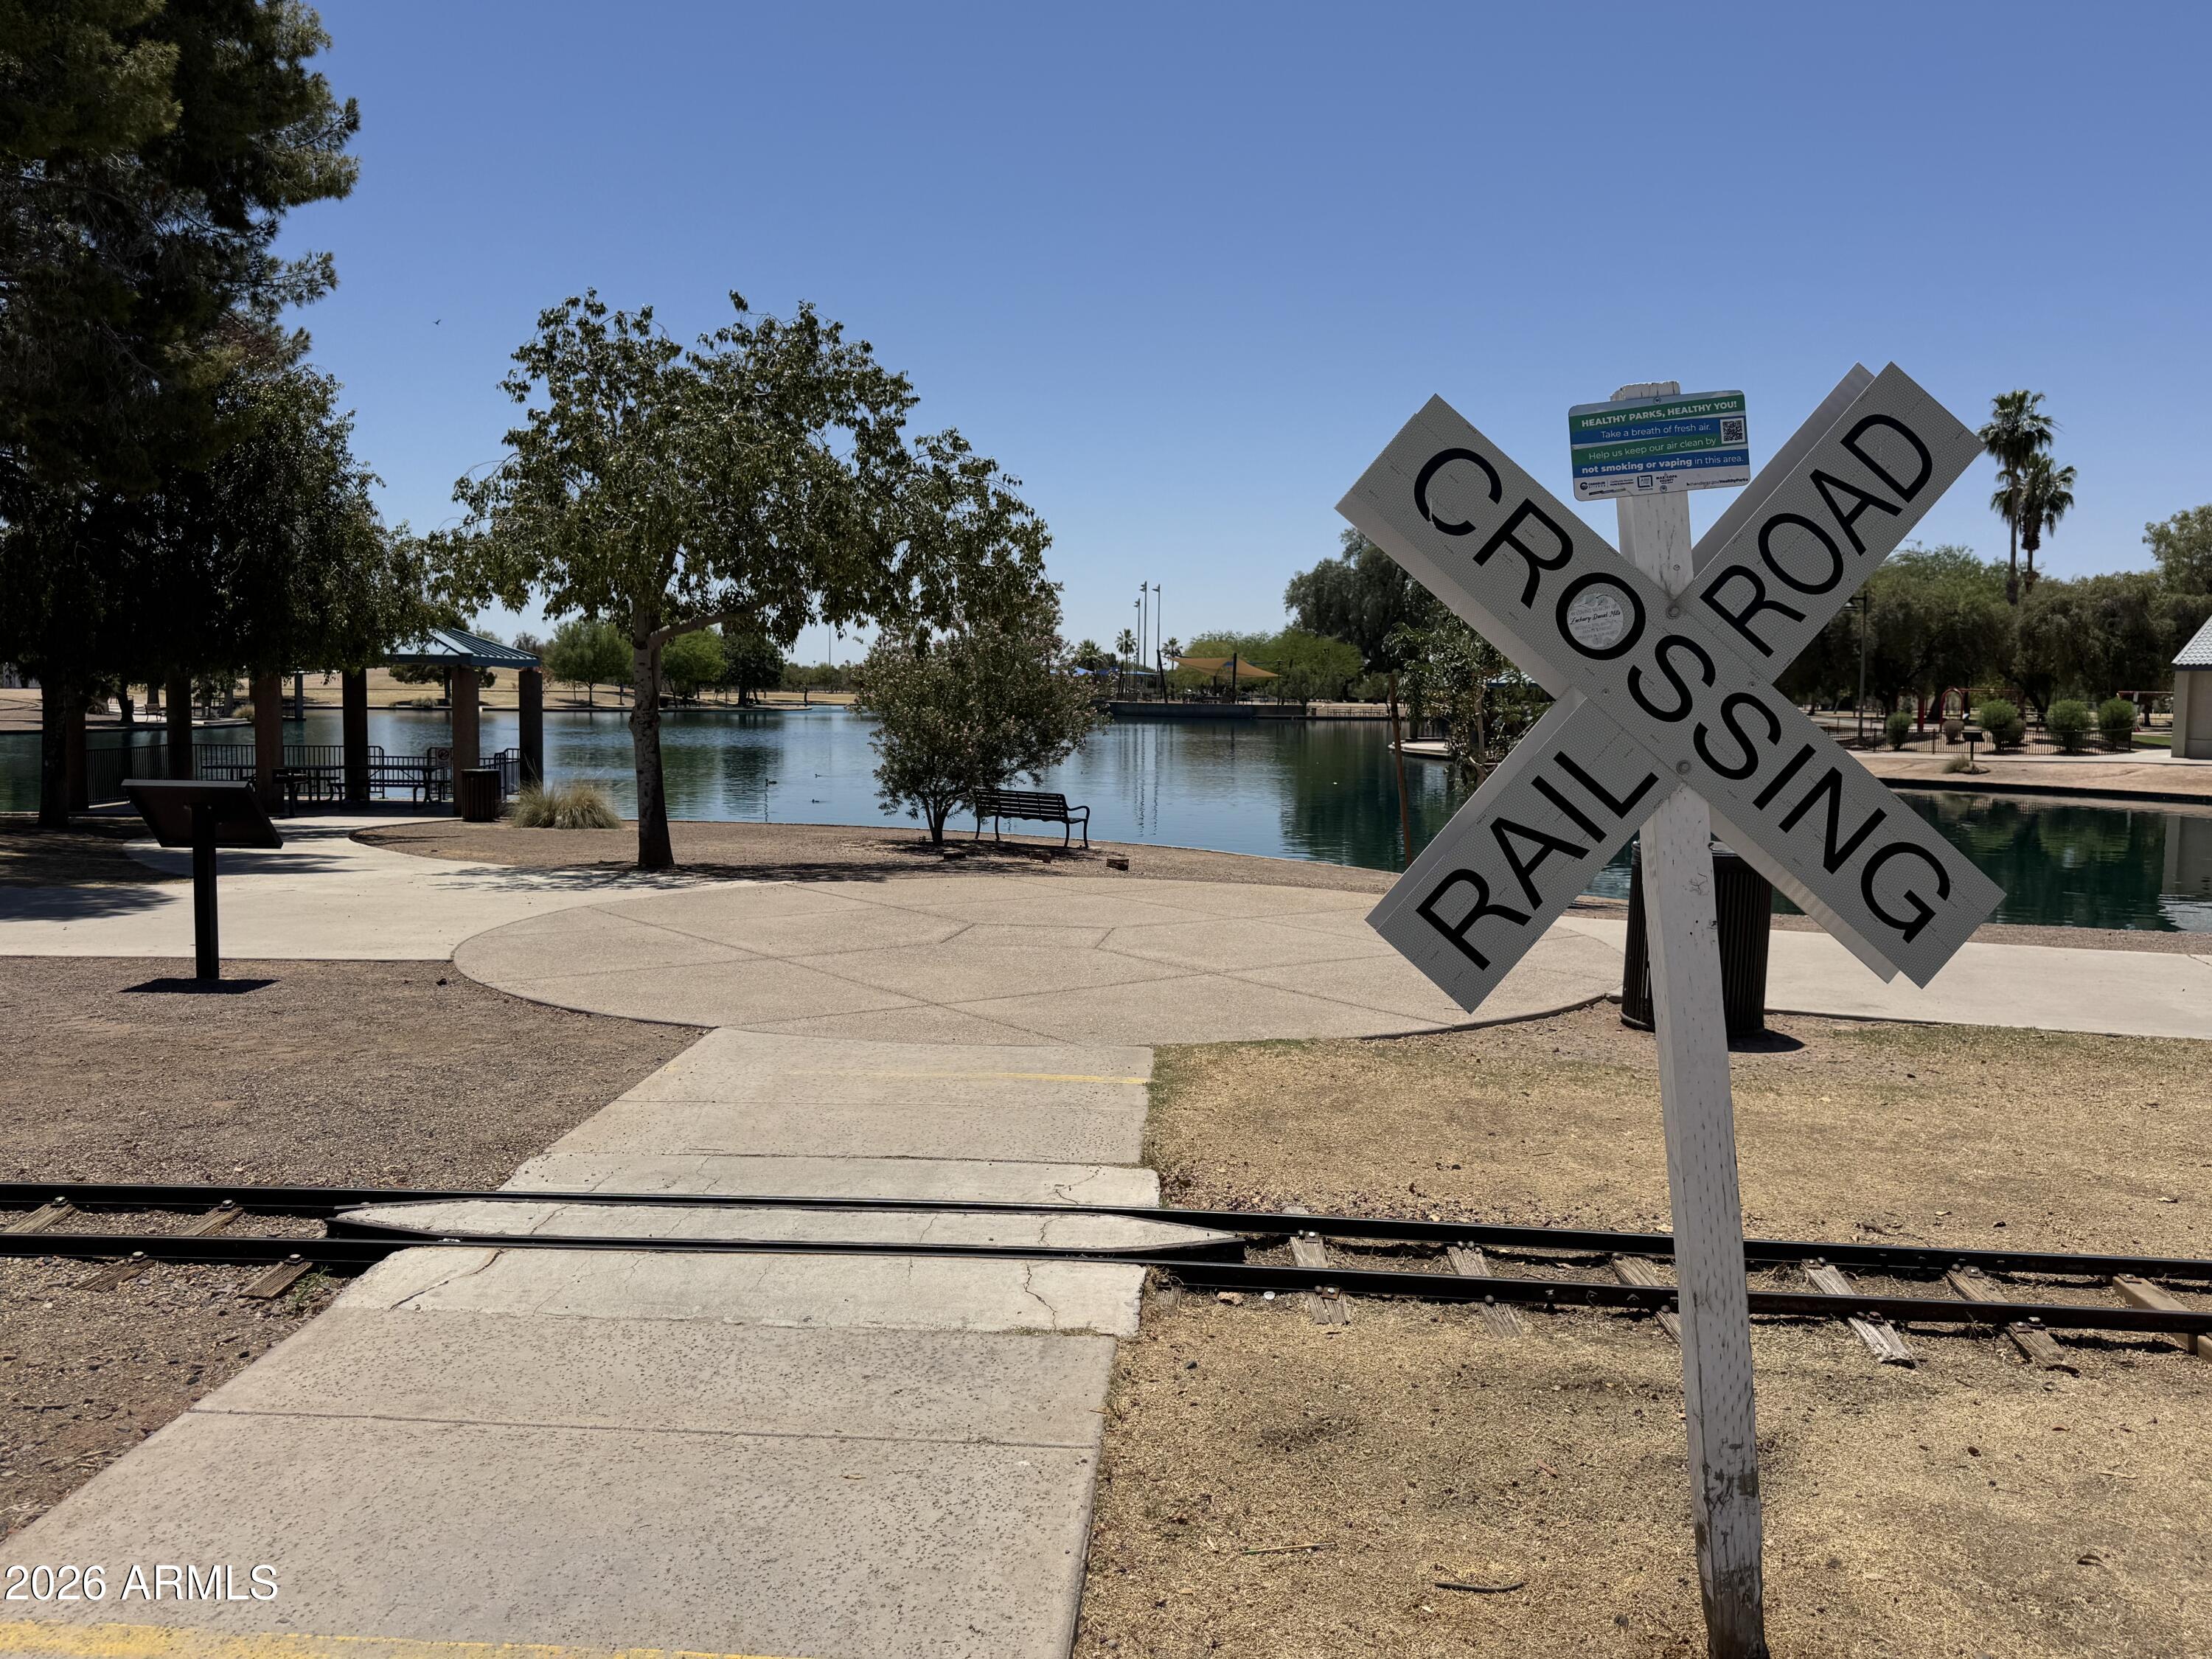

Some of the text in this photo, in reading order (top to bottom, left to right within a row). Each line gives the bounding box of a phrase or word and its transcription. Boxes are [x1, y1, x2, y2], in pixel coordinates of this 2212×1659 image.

[1582, 401, 1737, 427] HEALTHY PARKS, HEALTHY YOU!
[1601, 430, 1621, 439] Take
[1631, 426, 1660, 436] breath
[1663, 425, 1672, 434] of
[1674, 424, 1696, 432] fresh
[1699, 422, 1711, 431] air.
[1589, 451, 1610, 460] Help
[1667, 442, 1678, 450] air
[1680, 439, 1703, 448] clean
[1705, 437, 1717, 446] by
[1582, 465, 1599, 473] not
[1601, 462, 1644, 472] smoking
[1658, 458, 1692, 468] vaping
[1705, 456, 1721, 464] this
[1414, 448, 1951, 945] CROSSING
[1415, 414, 1933, 972] RAIL ROAD
